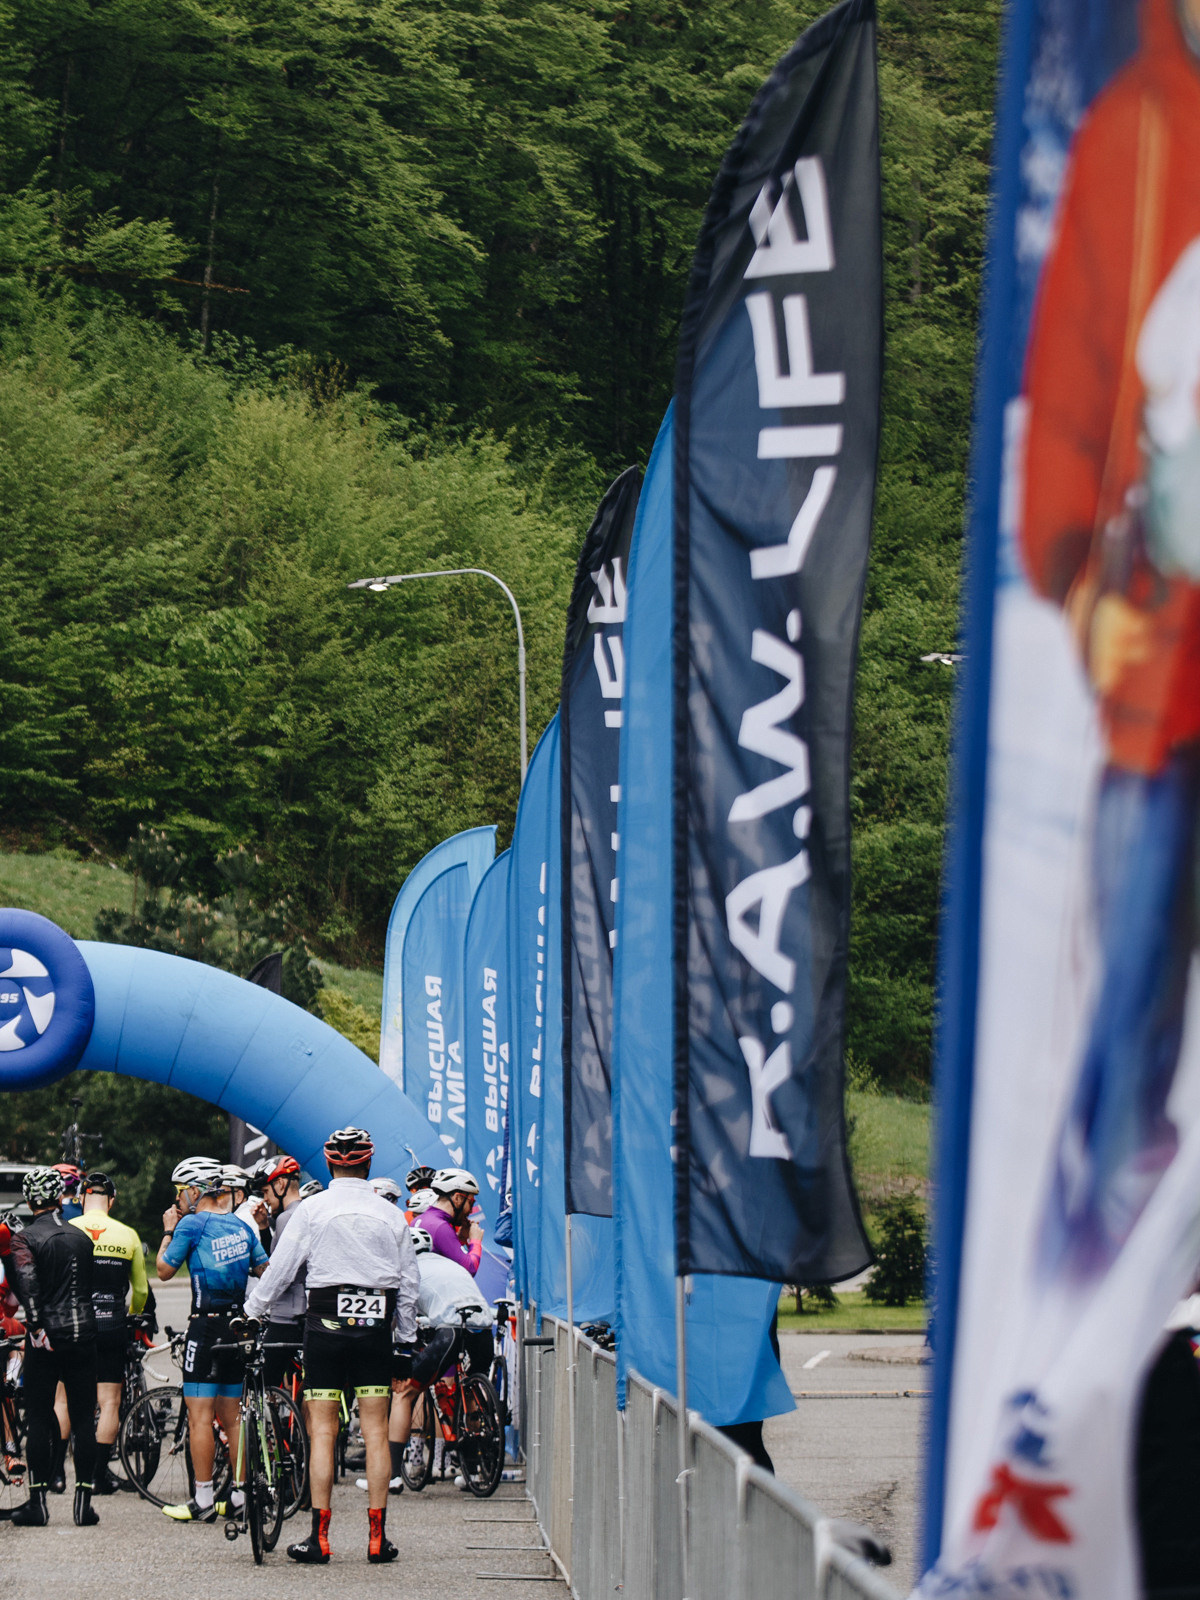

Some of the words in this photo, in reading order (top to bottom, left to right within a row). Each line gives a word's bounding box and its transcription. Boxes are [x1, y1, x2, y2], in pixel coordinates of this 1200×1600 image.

[425, 975, 445, 1123] ВЫСШАЯ
[446, 1040, 466, 1128] ЛИГА
[482, 967, 498, 1133] ВЫСШАЯ
[212, 1242, 249, 1261] ТРЕНЕР
[340, 1298, 381, 1314] 224
